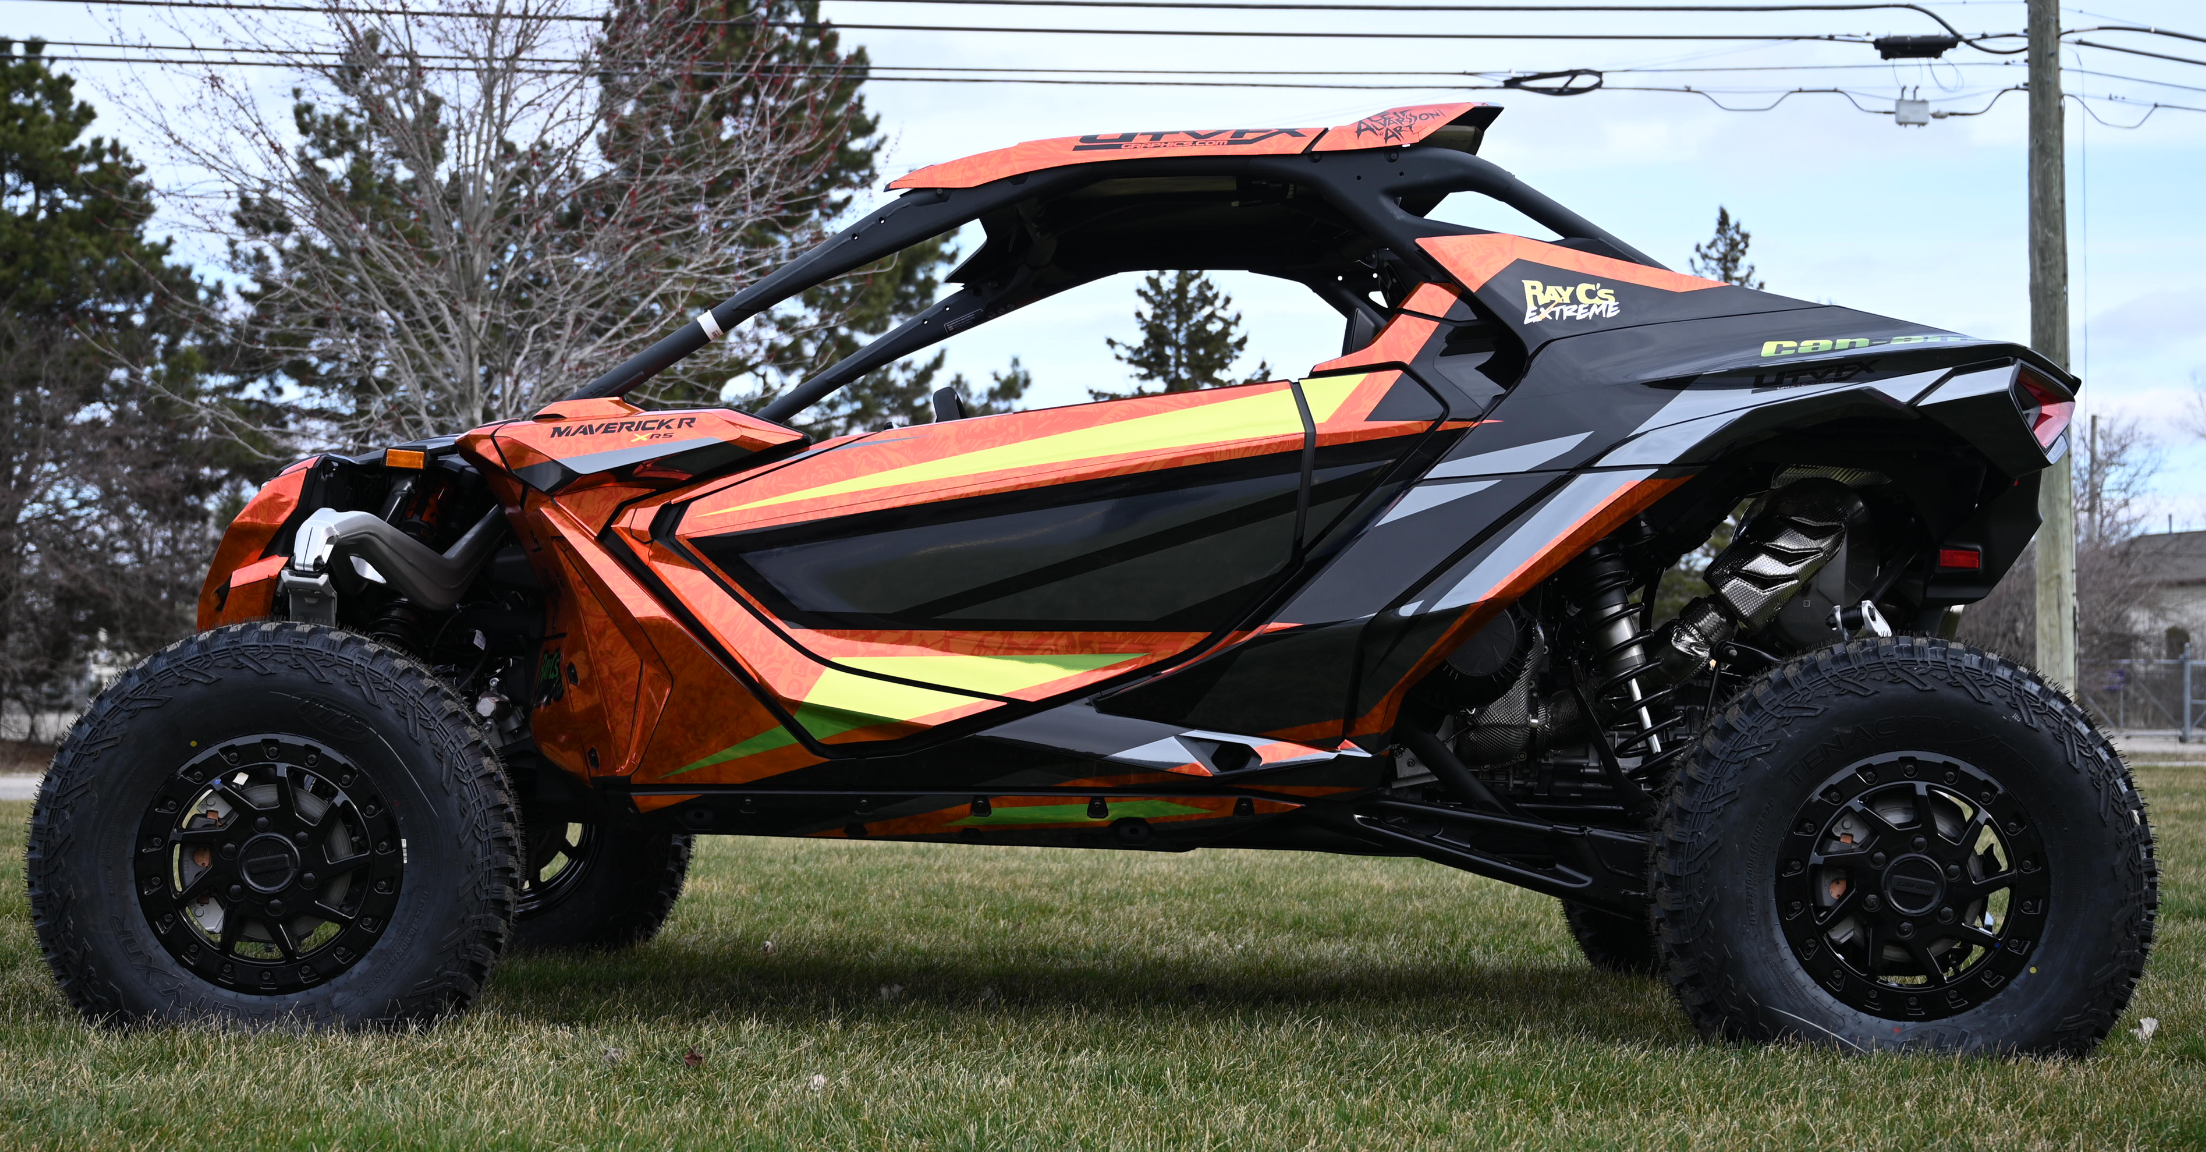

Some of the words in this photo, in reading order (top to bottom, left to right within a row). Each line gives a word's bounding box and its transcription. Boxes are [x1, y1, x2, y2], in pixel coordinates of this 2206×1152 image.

[1121, 139, 1228, 149] GRAPHICS.COM
[1521, 279, 1576, 305] RAY
[1523, 301, 1621, 325] EXTREME
[1752, 358, 1882, 389] UTVFX
[550, 417, 677, 439] MAVERICK
[677, 417, 696, 429] R
[630, 432, 674, 443] XRS
[1782, 714, 1960, 786] TENACITY
